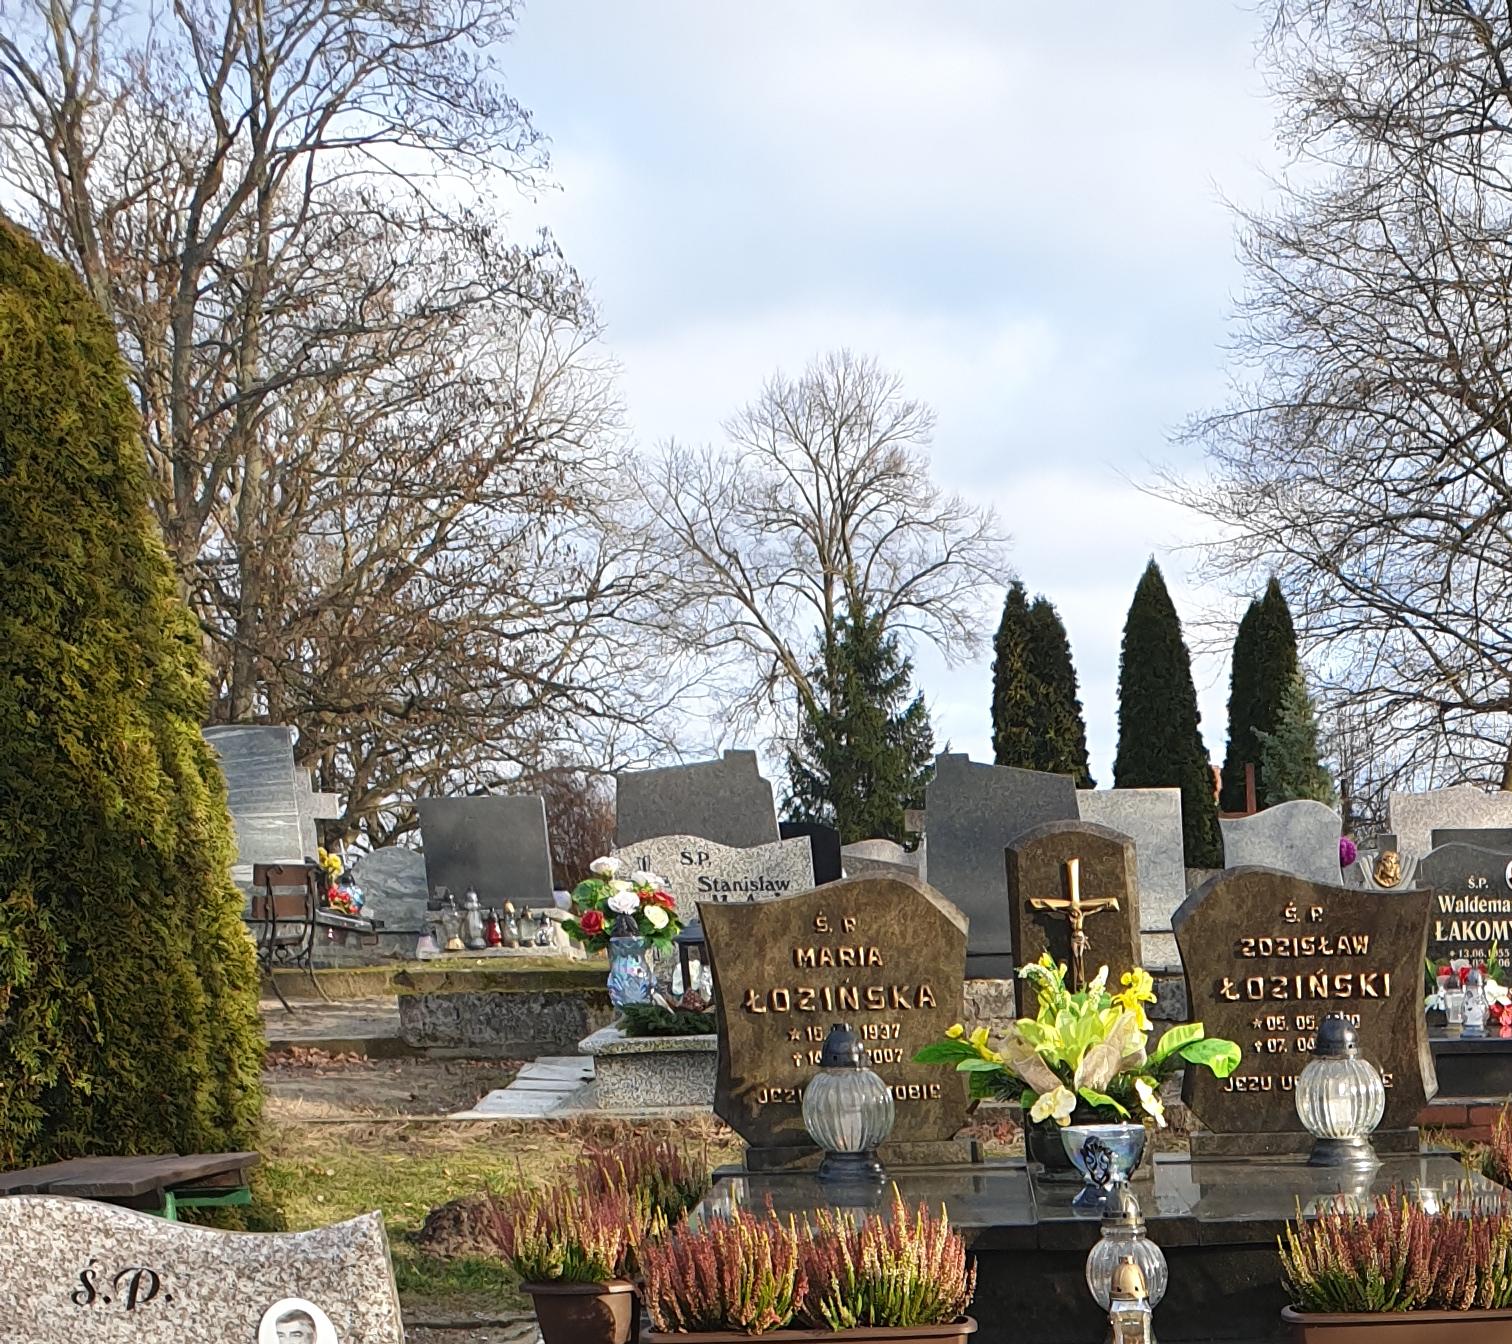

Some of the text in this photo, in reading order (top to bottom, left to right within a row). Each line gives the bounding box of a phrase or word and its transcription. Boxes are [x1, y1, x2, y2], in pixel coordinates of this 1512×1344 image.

[796, 947, 884, 967] MARIA
[1239, 935, 1369, 958] ZDZISŁAW
[1219, 968, 1391, 1000] ŁOZIŃSKI
[745, 977, 938, 1014] ŁOZIŃSKA
[861, 1023, 901, 1040] 1937
[757, 1087, 803, 1105] JEZ
